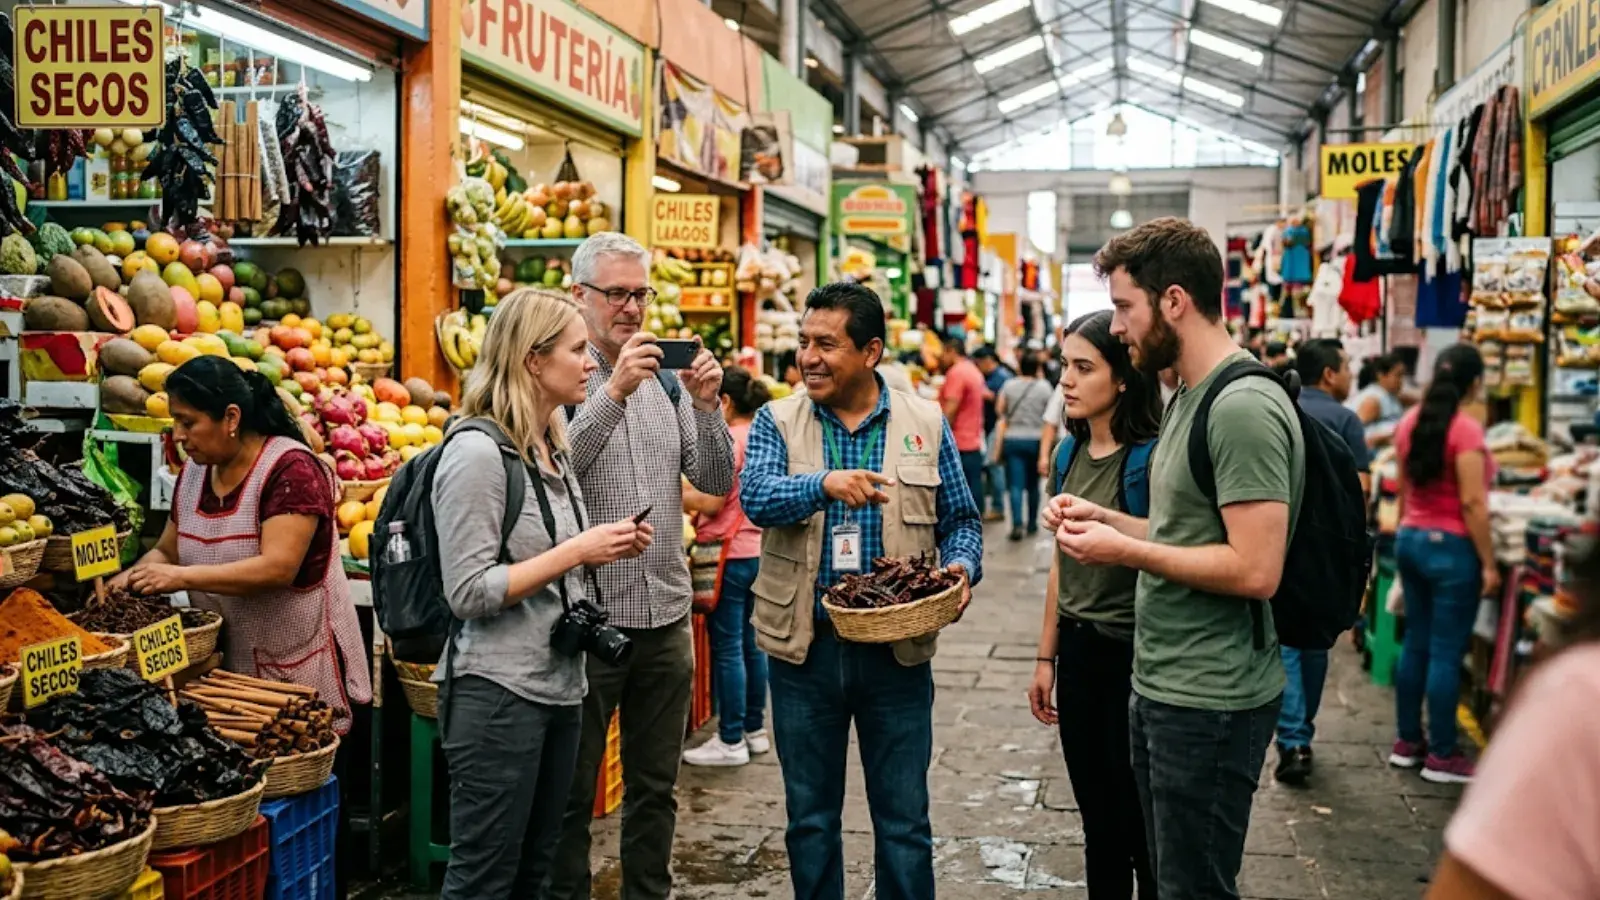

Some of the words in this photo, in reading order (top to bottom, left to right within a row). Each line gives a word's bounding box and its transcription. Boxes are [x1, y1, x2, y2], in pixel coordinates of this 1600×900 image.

[24, 18, 154, 64] CHILES
[479, 0, 628, 114] FRUTERÍA
[30, 72, 149, 117] SECOS
[1327, 147, 1409, 175] MOLES
[656, 200, 713, 222] CHILES
[76, 537, 116, 567] MOLES
[140, 622, 180, 653] CHILES
[27, 641, 78, 673] CHILES
[145, 645, 182, 675] SECOS
[31, 666, 78, 698] SECOS
